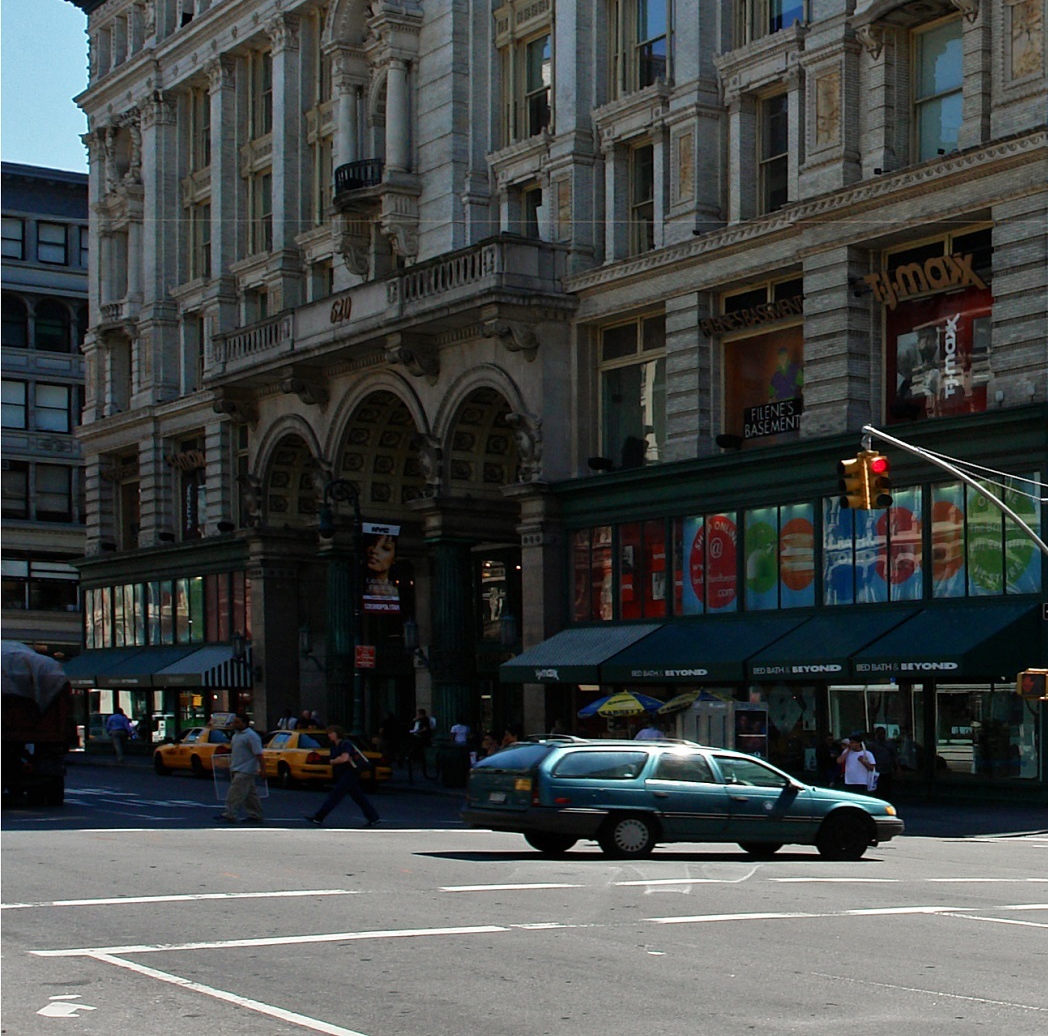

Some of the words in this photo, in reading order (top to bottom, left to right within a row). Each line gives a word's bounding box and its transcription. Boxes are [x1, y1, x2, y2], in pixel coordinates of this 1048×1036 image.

[331, 296, 352, 323] 620
[751, 401, 794, 421] FILENE'S
[744, 414, 800, 438] BASEMENT
[664, 668, 708, 677] BEYOND
[753, 667, 765, 675] BED
[767, 666, 784, 674] BATH
[792, 664, 842, 673] BEYOND
[856, 663, 870, 672] BED
[872, 663, 892, 671] BATH
[900, 662, 958, 671] BEYOND
